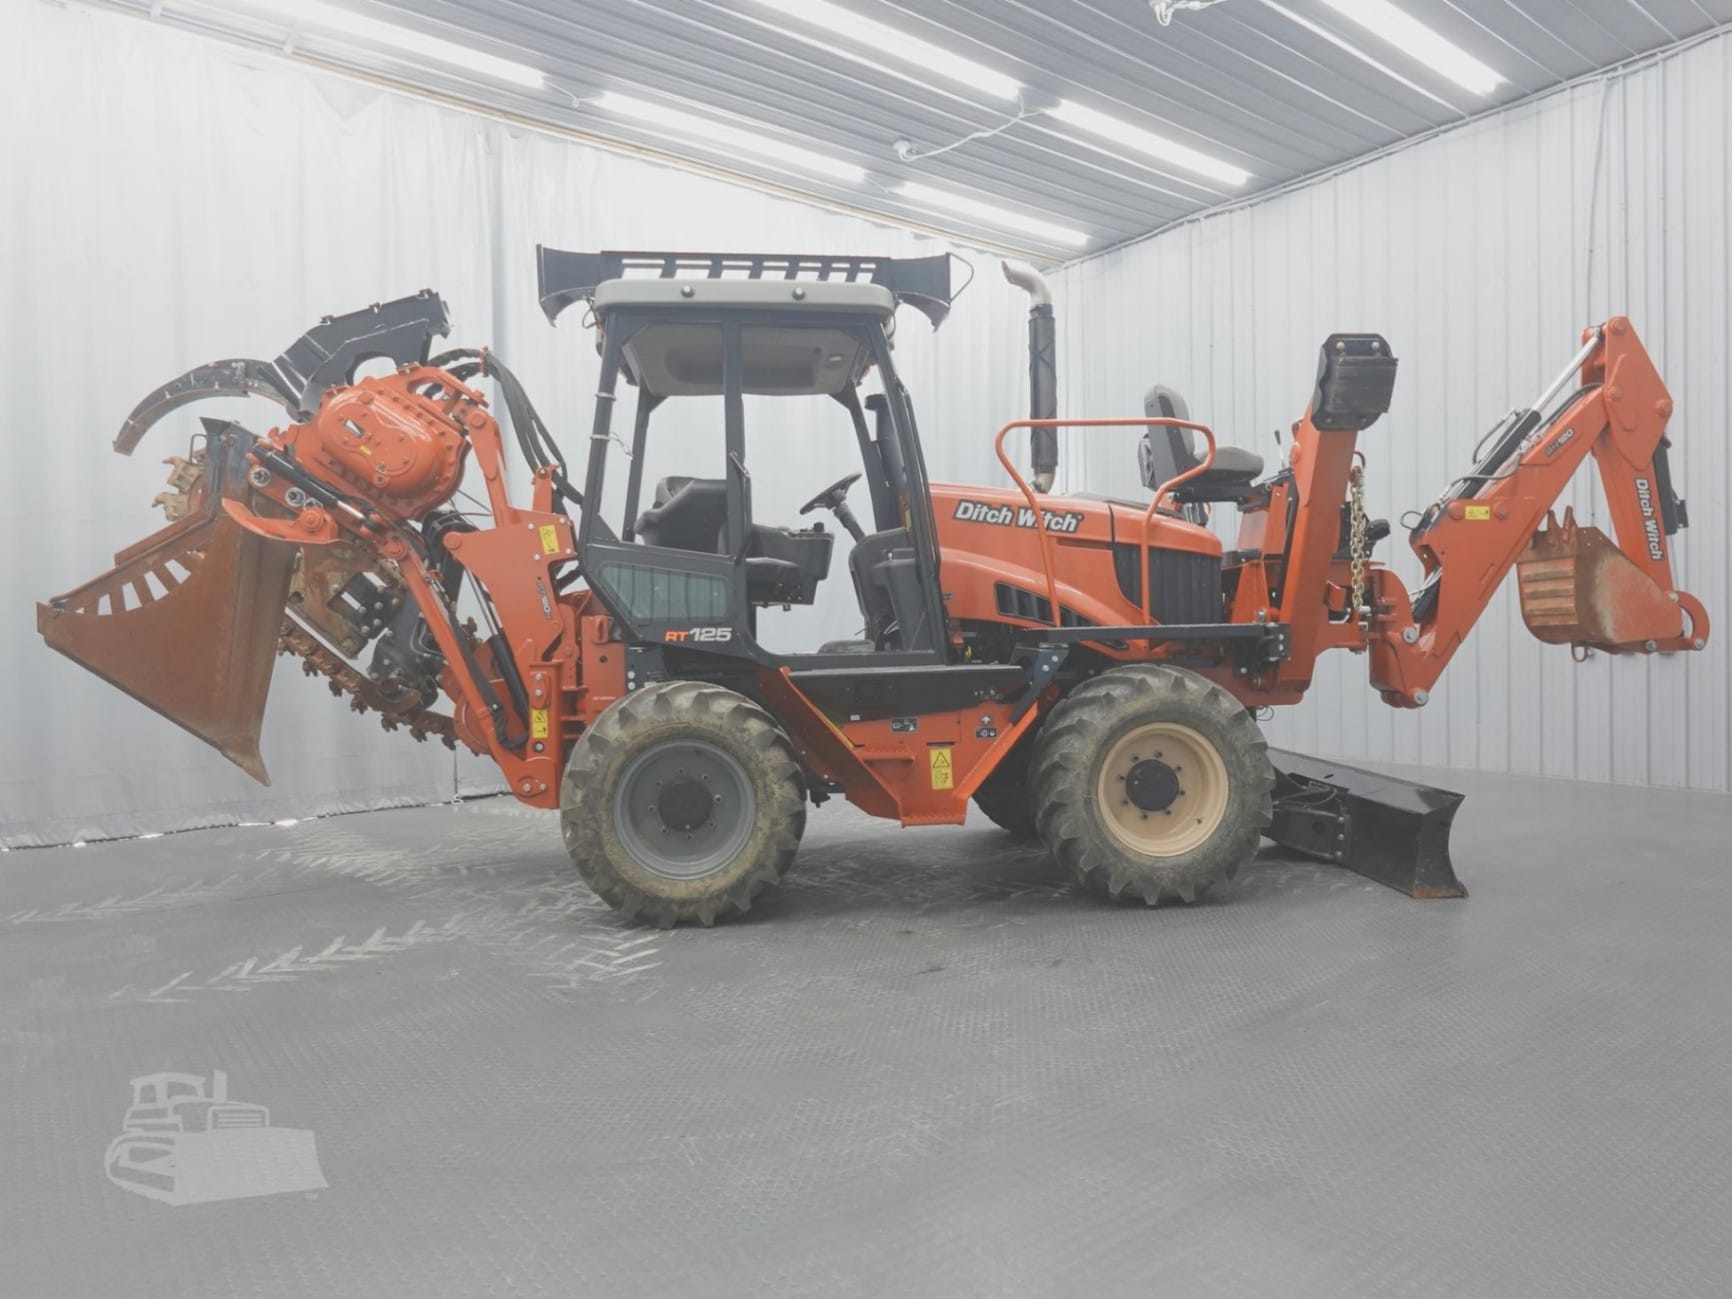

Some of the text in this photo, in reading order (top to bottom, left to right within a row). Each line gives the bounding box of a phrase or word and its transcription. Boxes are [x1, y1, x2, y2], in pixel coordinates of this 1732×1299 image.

[954, 500, 1013, 525] Ditch
[1635, 478, 1664, 560] Ditch Witch
[664, 627, 732, 642] RT125
